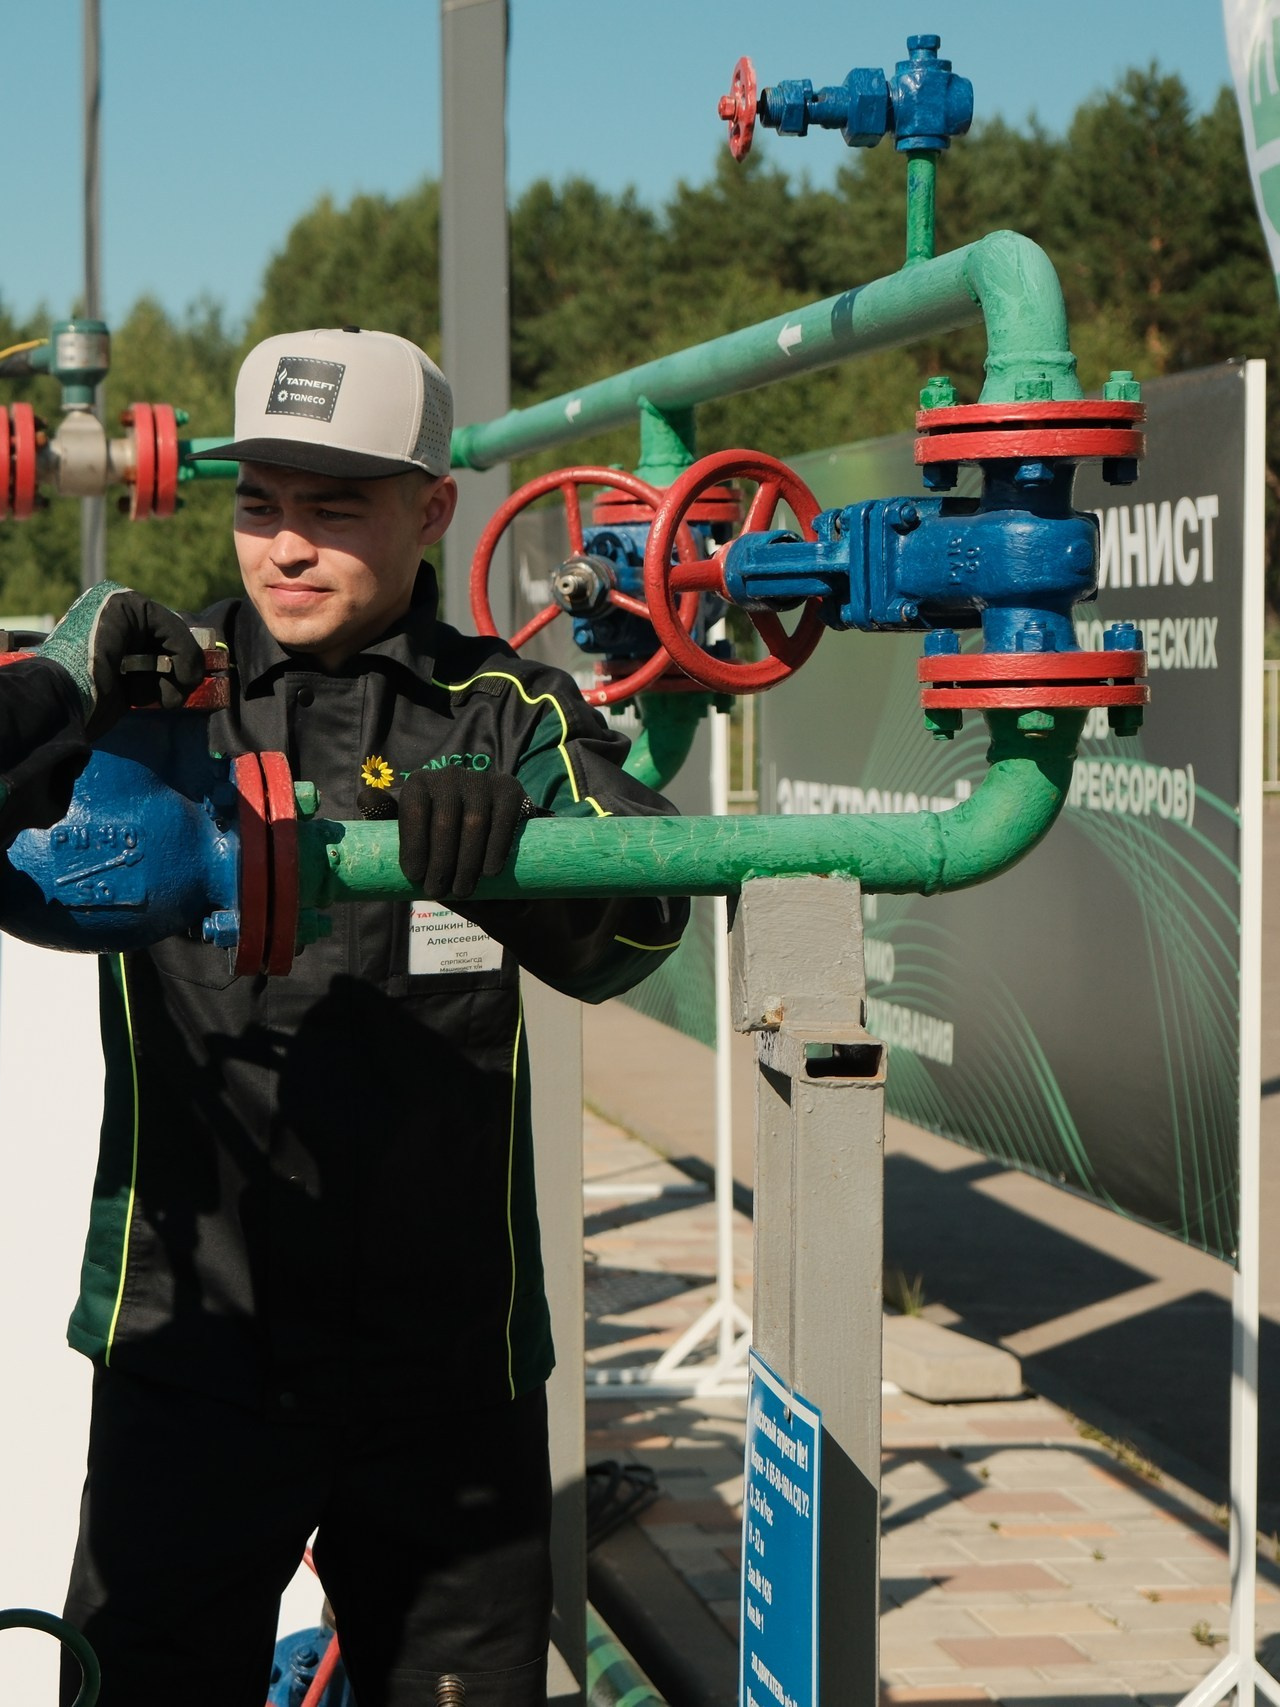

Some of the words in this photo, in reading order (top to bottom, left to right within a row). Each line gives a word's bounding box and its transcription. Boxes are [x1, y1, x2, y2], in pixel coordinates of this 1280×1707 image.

[286, 377, 335, 391] TATNEFT
[1083, 494, 1219, 590] ИНИСТ
[1065, 758, 1196, 829] РЕССОРОВ)
[427, 935, 490, 946] Алексеевич
